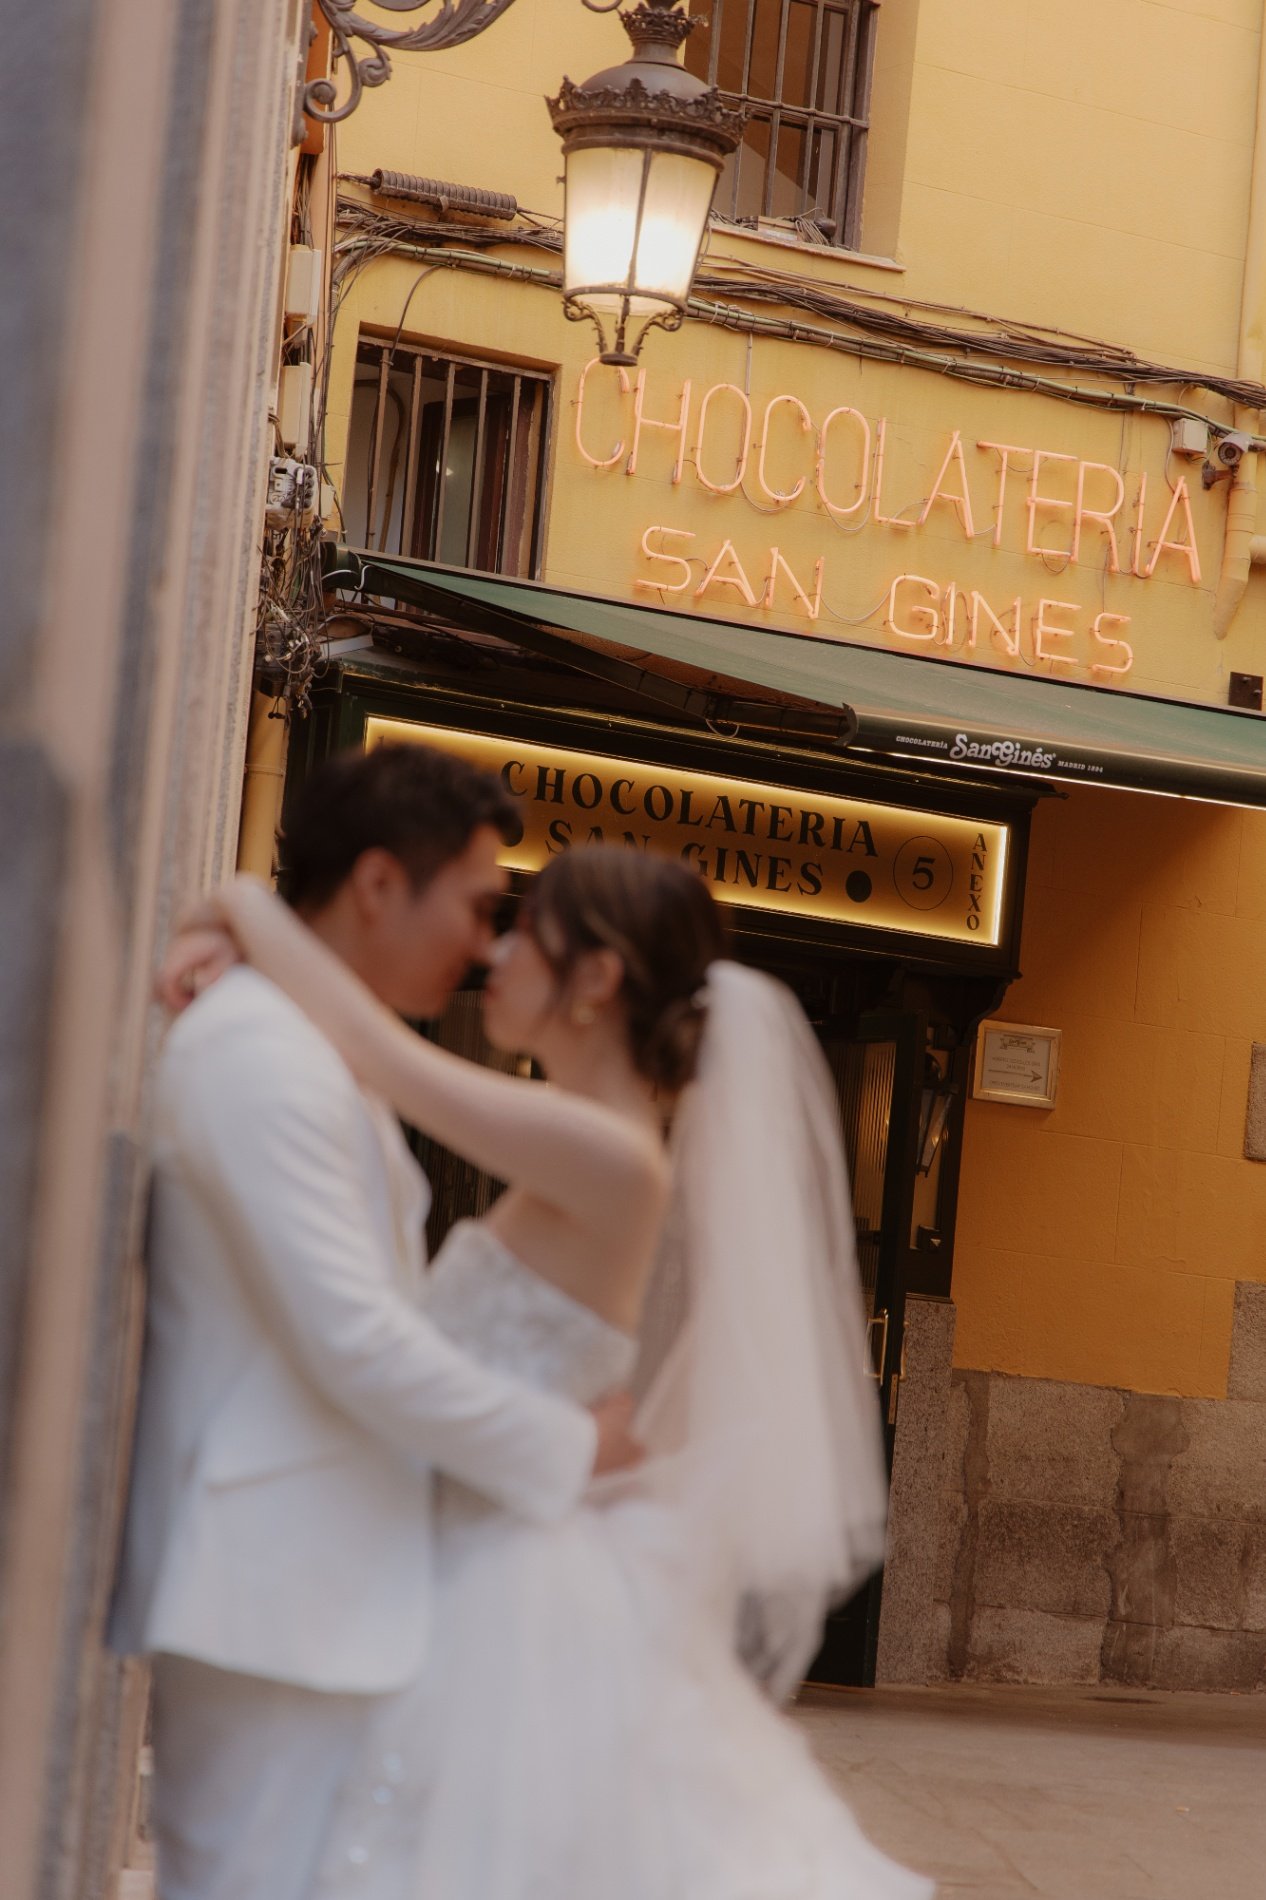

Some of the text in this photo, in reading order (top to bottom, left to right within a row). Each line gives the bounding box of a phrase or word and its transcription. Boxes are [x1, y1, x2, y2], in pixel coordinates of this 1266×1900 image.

[574, 357, 1201, 583] CHOCOLATERIA
[634, 525, 1134, 674] SAN GINES
[501, 760, 878, 857] CHOCOLATERIA
[1057, 760, 1086, 771] MADRID
[681, 842, 824, 896] GINES
[912, 856, 936, 890] 5
[965, 832, 988, 931] ANEXO
